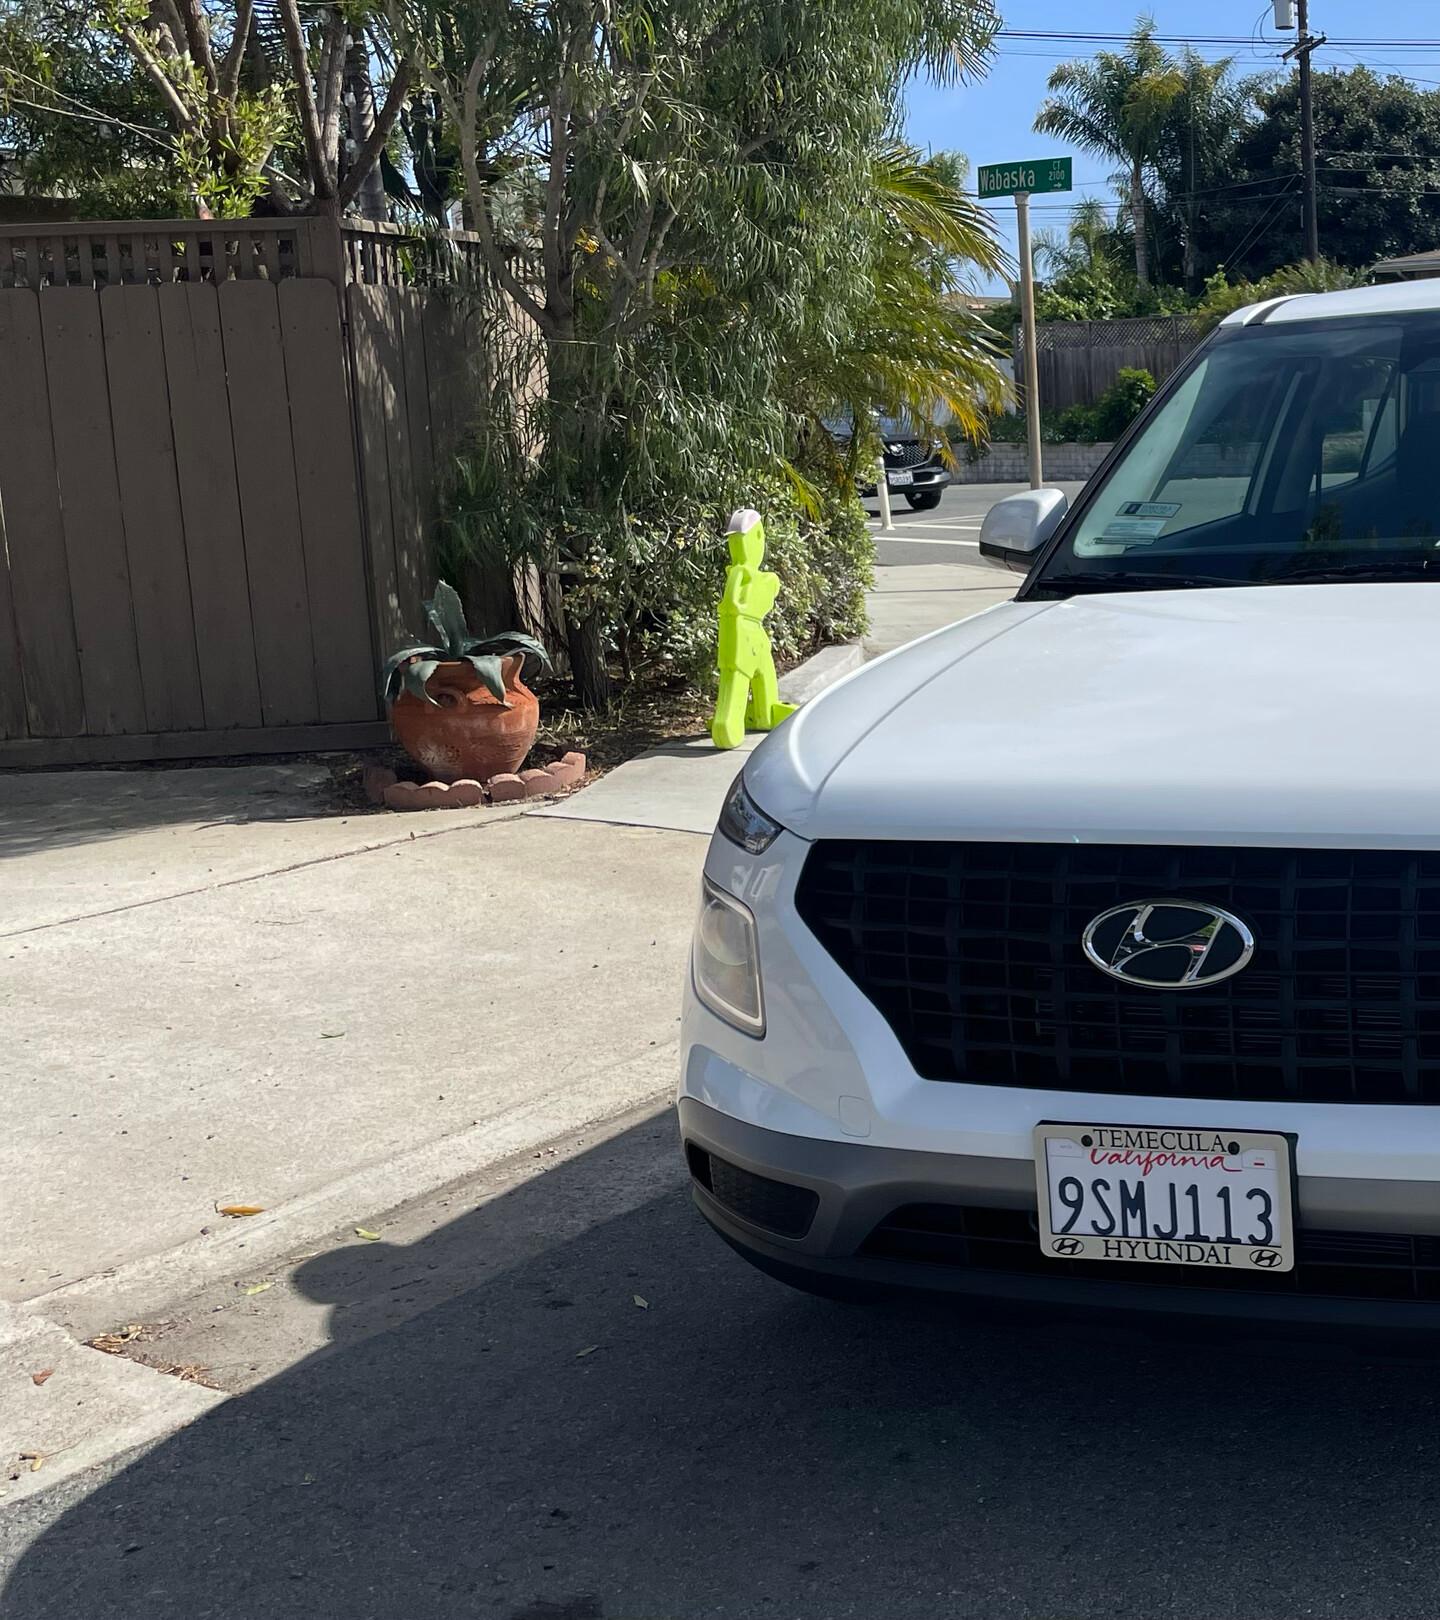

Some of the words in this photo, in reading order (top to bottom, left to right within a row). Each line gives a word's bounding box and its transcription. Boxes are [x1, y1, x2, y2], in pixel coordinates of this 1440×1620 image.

[1048, 170, 1065, 181] 2100
[1052, 160, 1061, 171] CT
[980, 166, 1036, 191] Wabaska
[1093, 1129, 1227, 1153] TEMECULA
[1090, 1148, 1243, 1177] California
[1057, 1176, 1273, 1246] 9SMJ113
[1103, 1239, 1232, 1265] HYUNDAI
